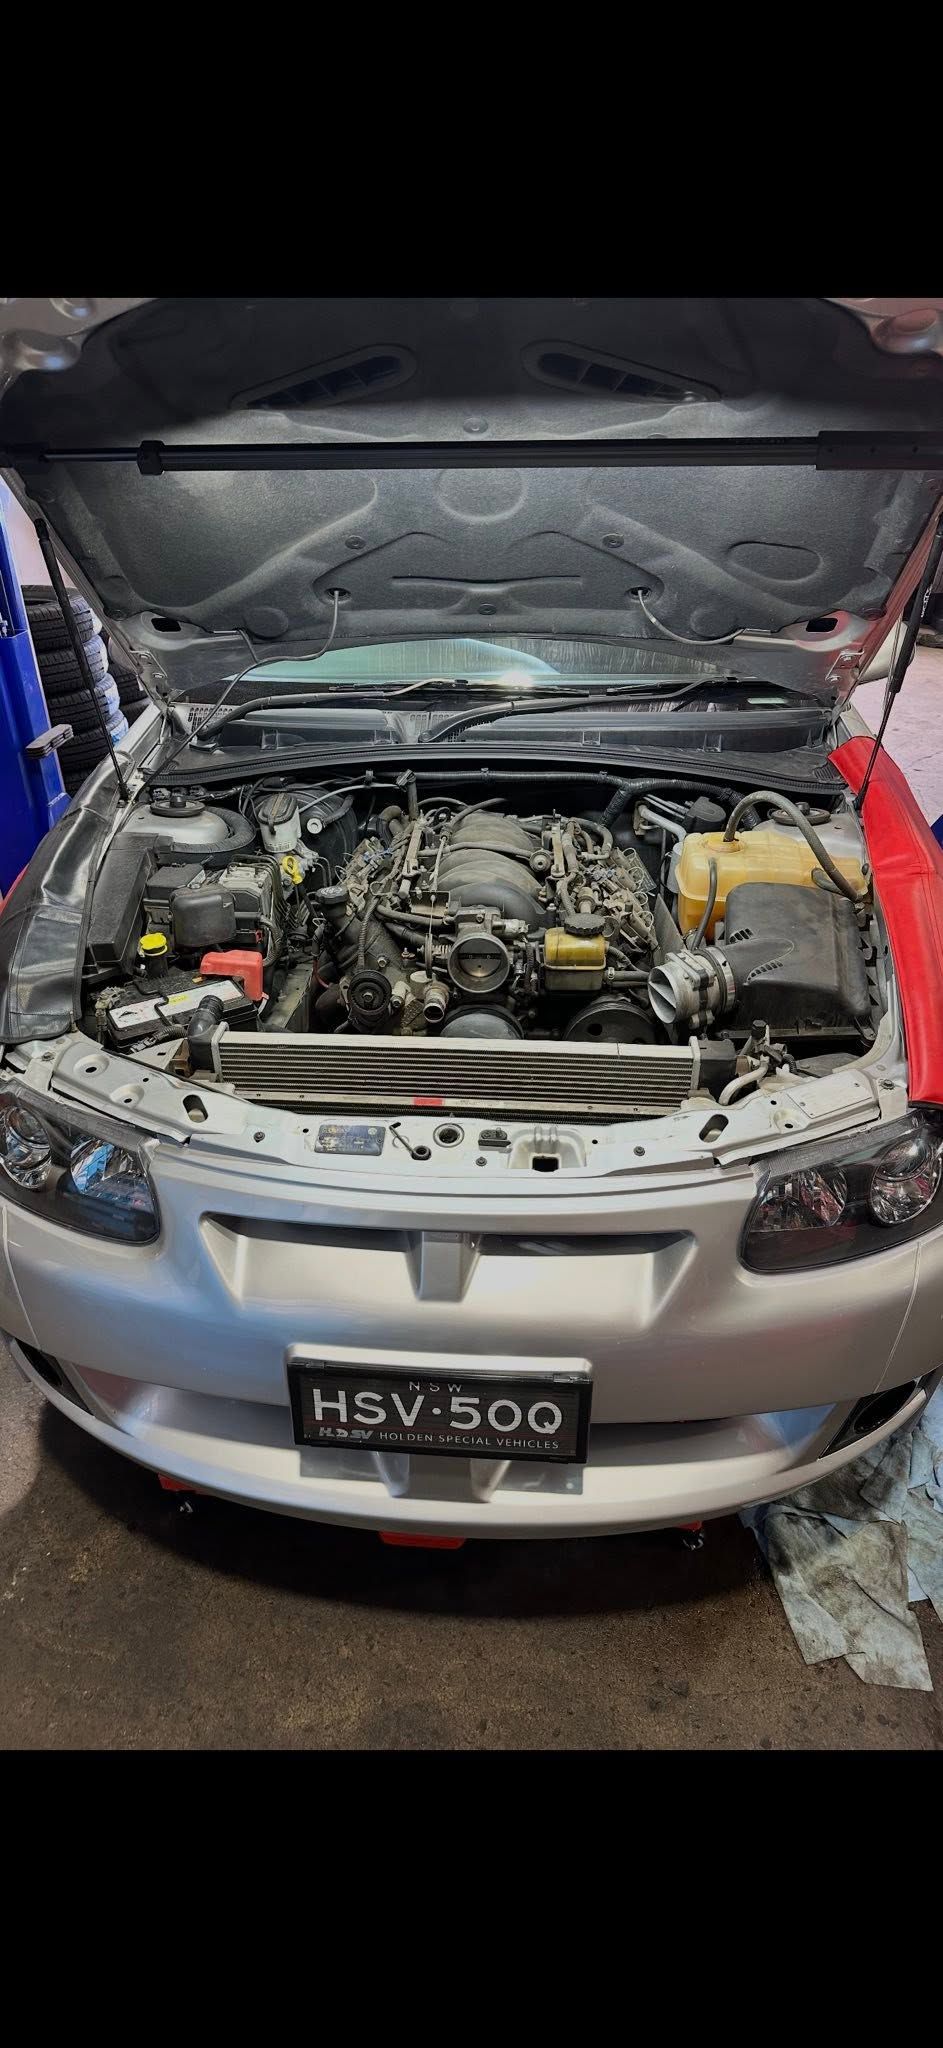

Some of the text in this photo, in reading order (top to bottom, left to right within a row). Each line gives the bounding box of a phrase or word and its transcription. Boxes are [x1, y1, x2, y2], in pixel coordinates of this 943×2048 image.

[380, 1432, 433, 1442] HOLDEN
[439, 1434, 491, 1446] SPECIAL
[497, 1439, 559, 1449] VEHICLES
